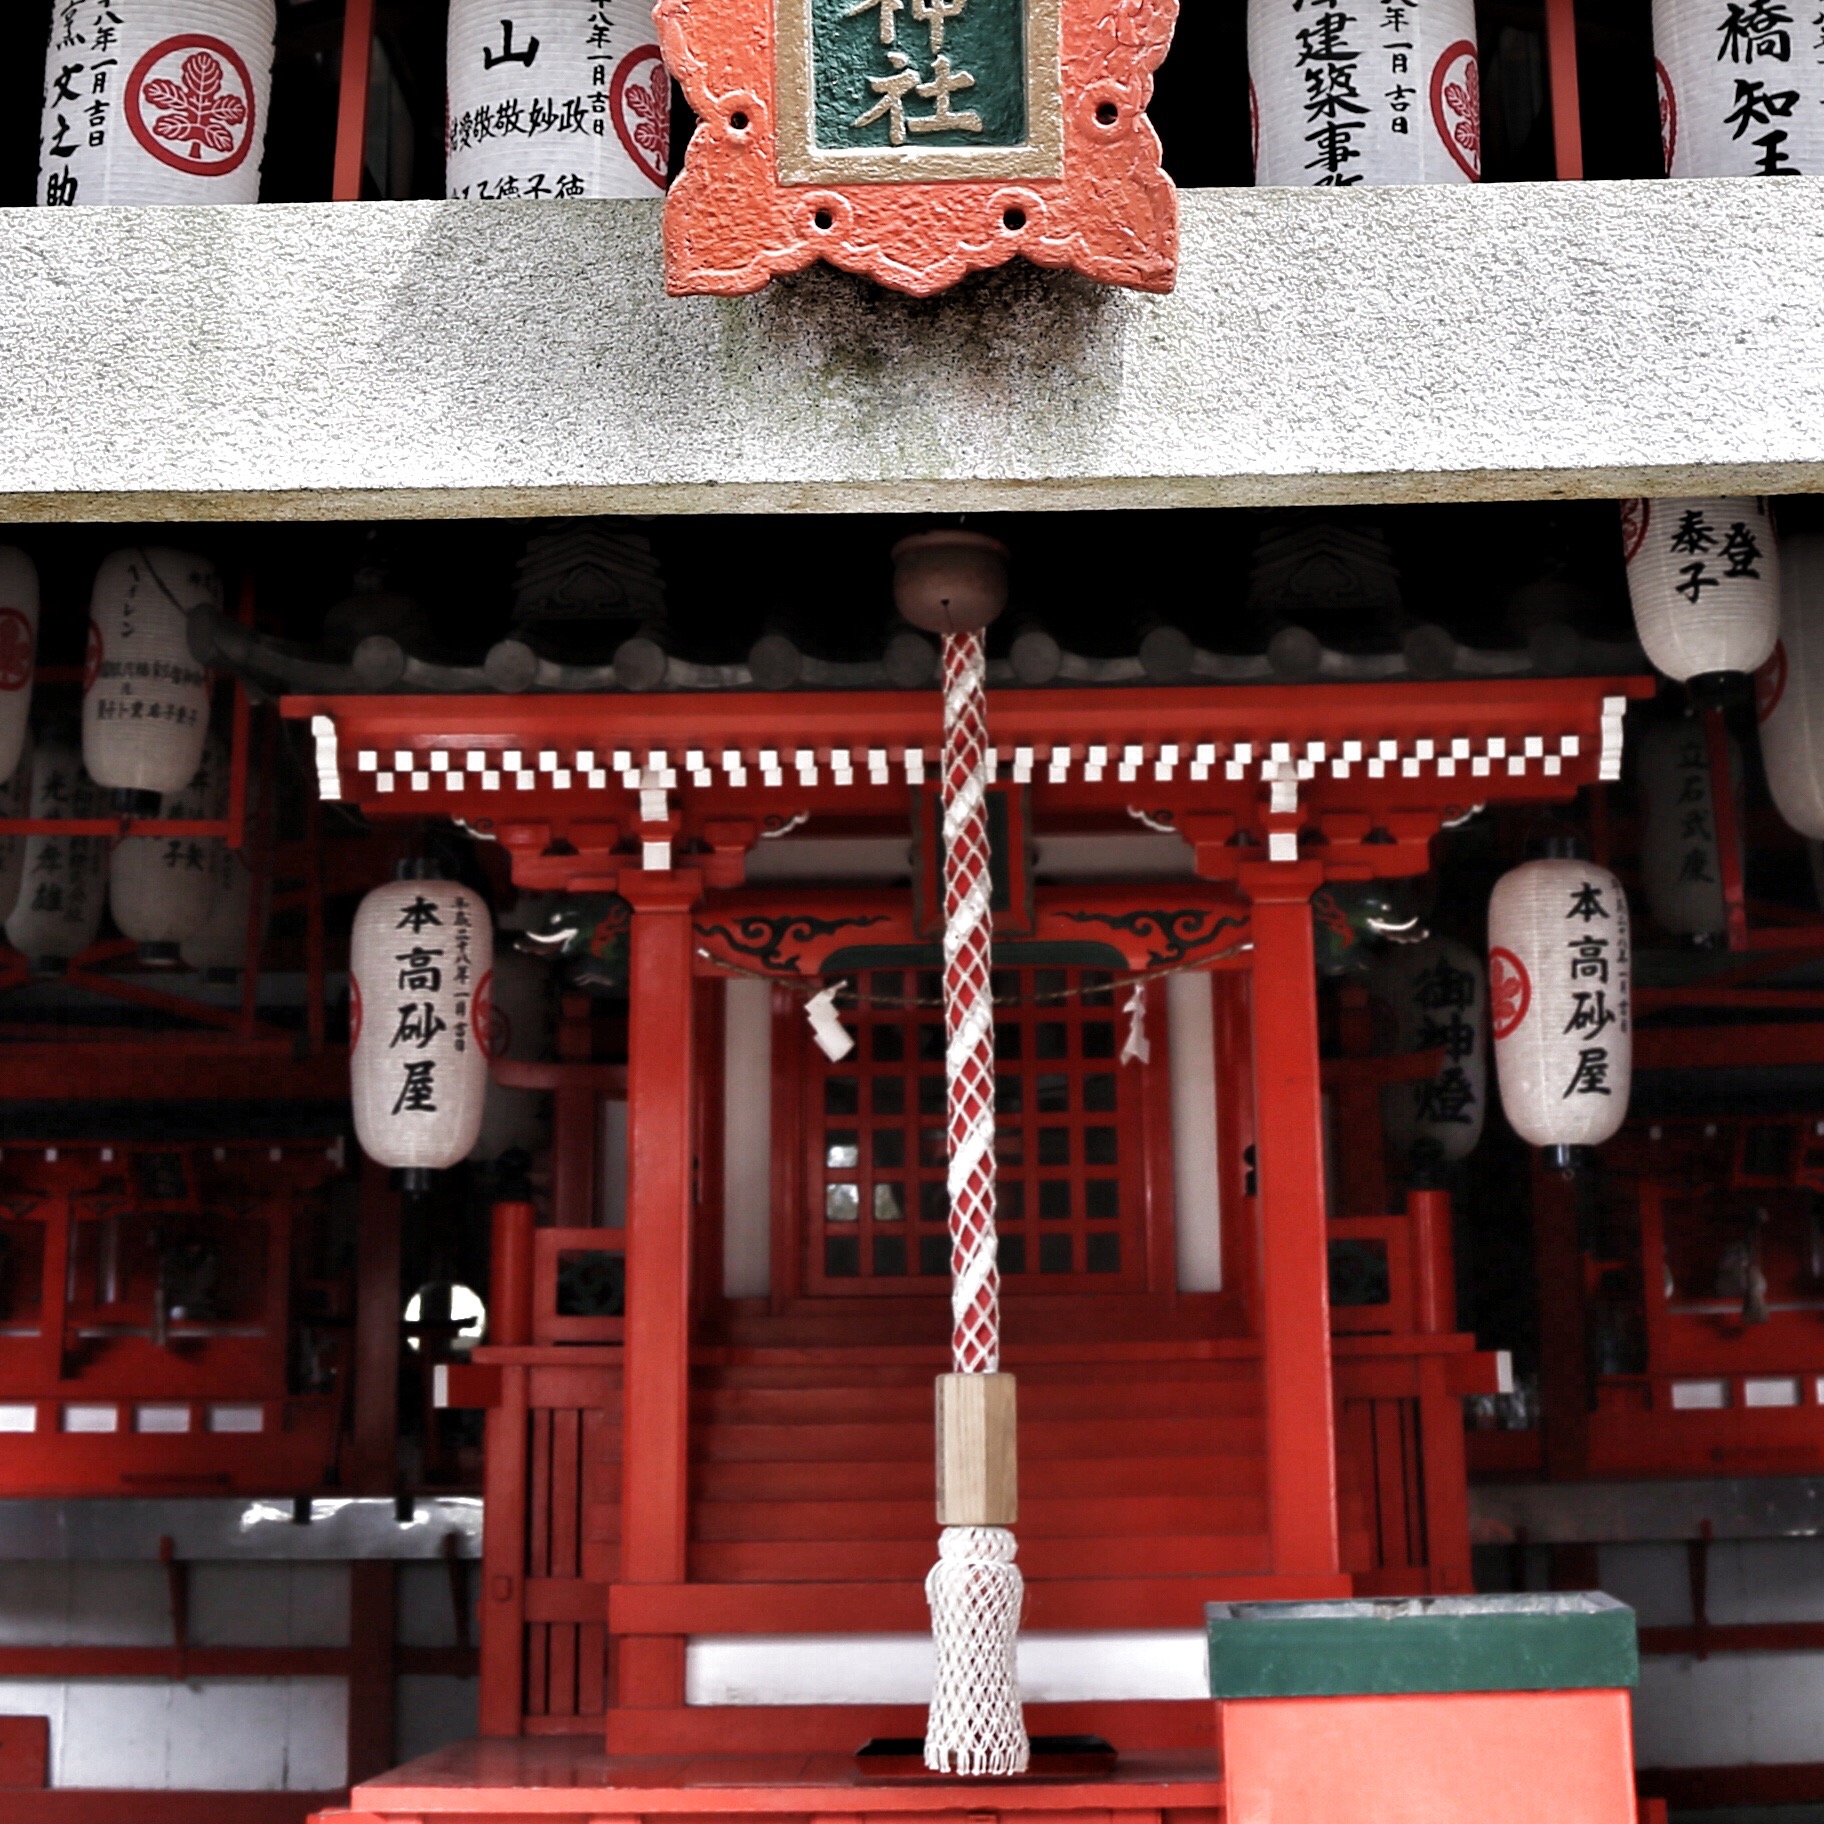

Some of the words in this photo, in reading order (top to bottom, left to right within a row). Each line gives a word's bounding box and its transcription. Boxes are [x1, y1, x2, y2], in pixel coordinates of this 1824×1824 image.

[1670, 509, 1720, 604] 泰子
[388, 895, 447, 1116] 本高砂屋
[1563, 881, 1616, 1100] 本高砂屋
